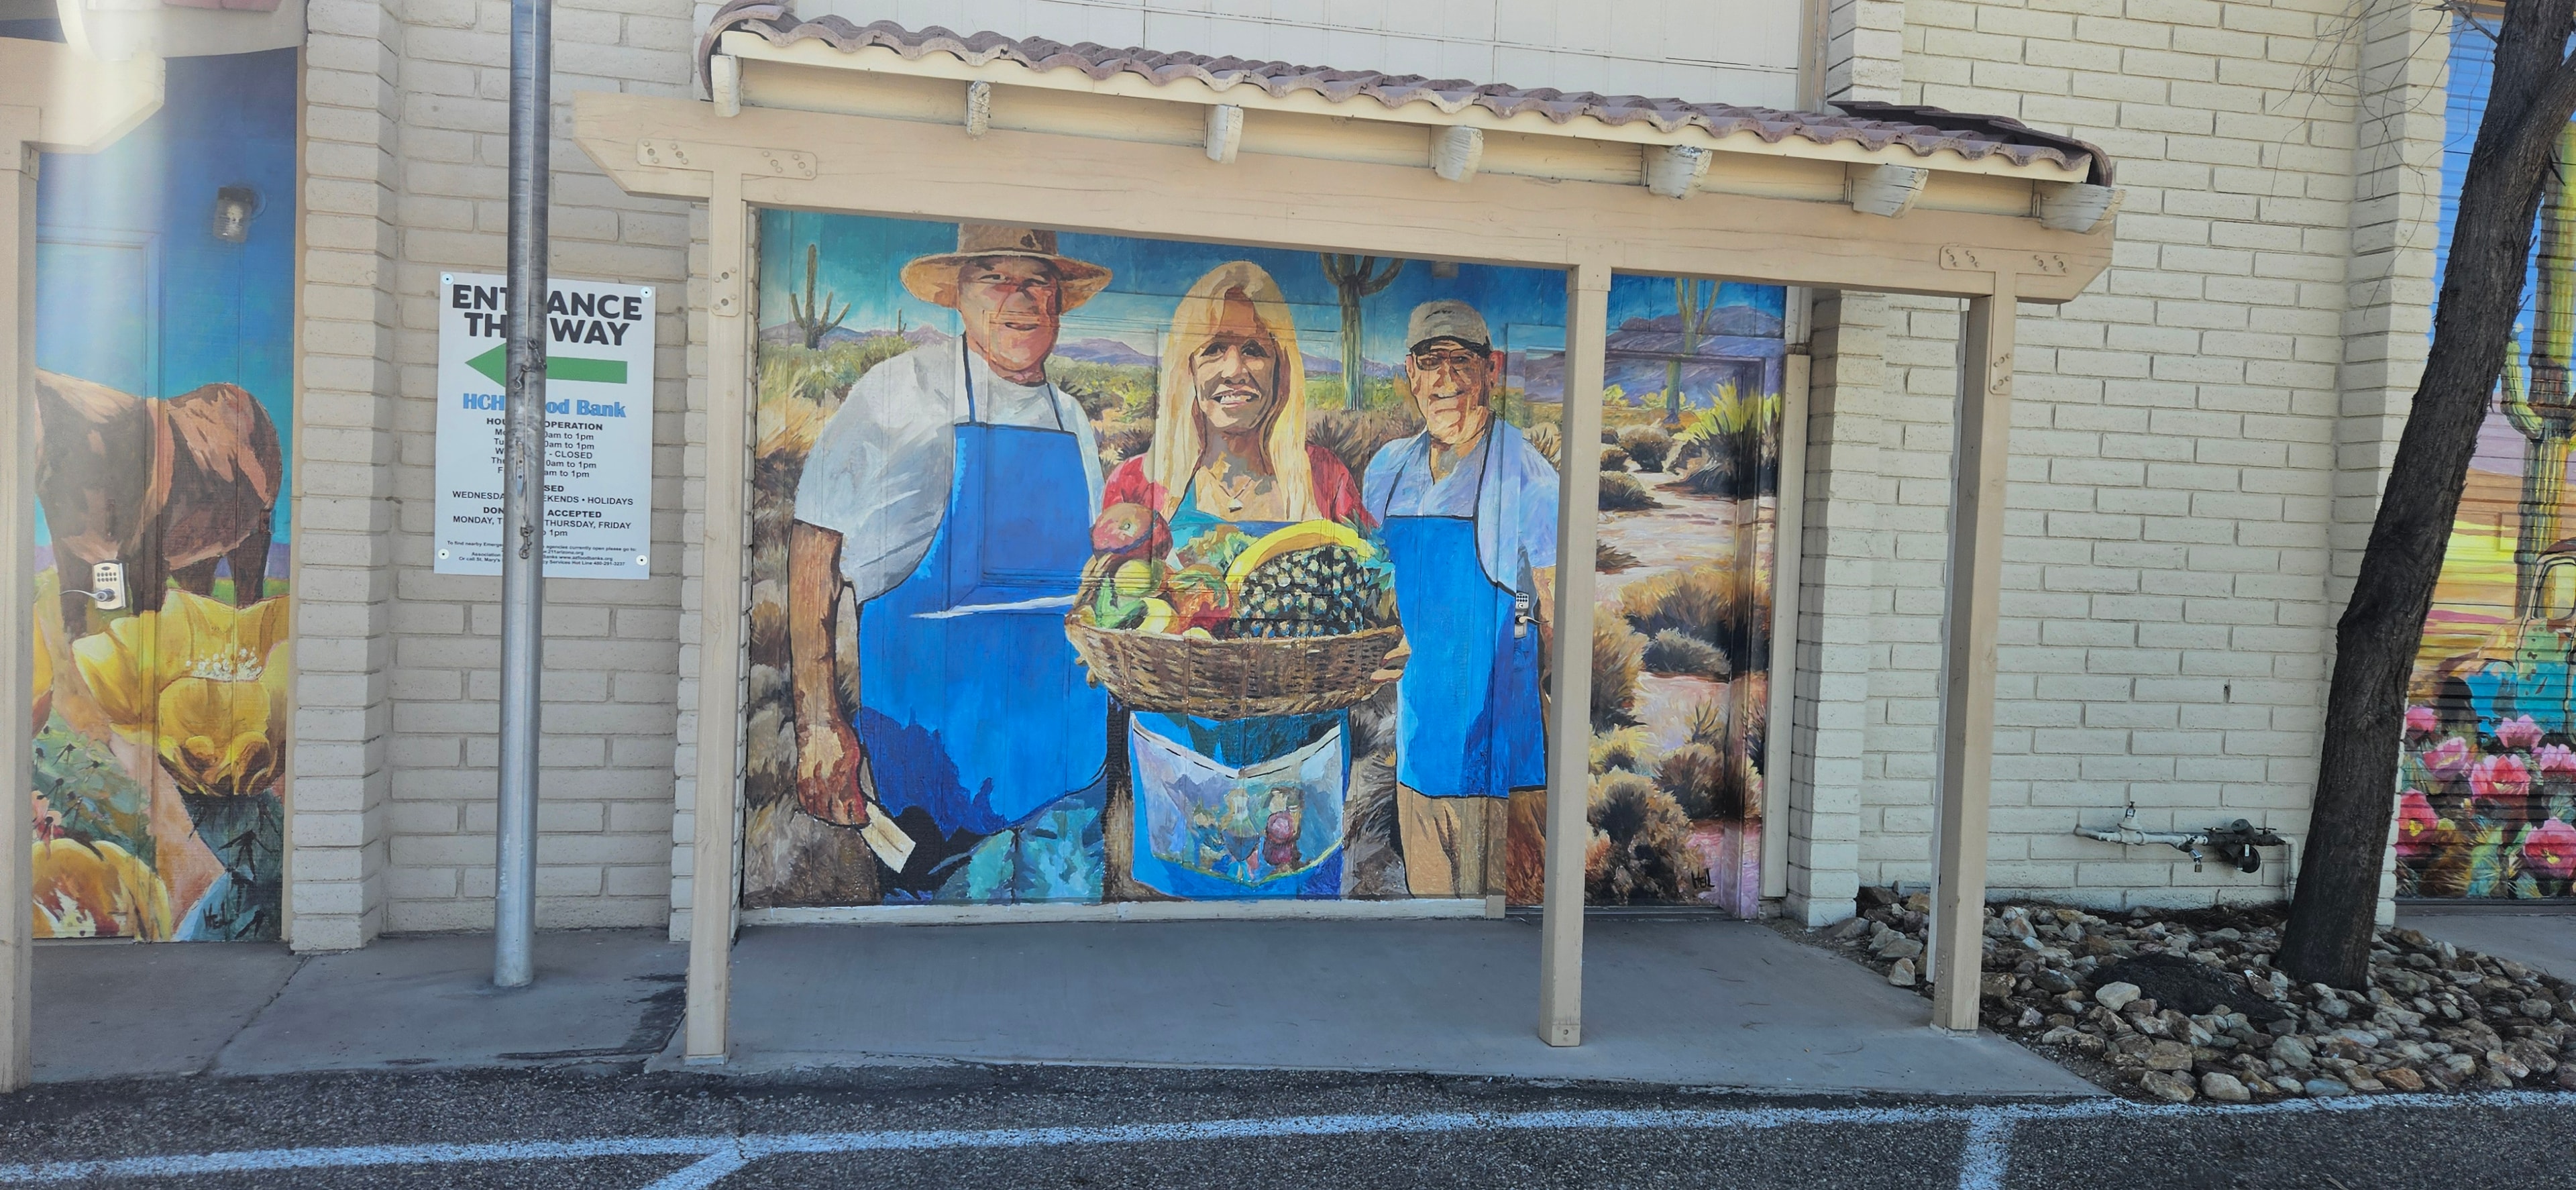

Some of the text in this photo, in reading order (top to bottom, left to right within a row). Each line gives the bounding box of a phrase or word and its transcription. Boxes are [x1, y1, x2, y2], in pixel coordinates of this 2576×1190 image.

[452, 284, 642, 321] ENANCE
[549, 317, 630, 345] WAY
[545, 398, 570, 415] od
[576, 399, 627, 418] Bank
[545, 421, 603, 431] OPERATION
[544, 431, 594, 441] 0am to 1pm
[565, 440, 574, 449] to
[576, 442, 594, 450] 1pm
[555, 450, 593, 459] CLOSED
[567, 459, 576, 468] to
[578, 462, 597, 470] 1pm
[544, 484, 564, 492] SED
[452, 490, 634, 505] WEDNESDA EKENDS HOLIDAYS
[547, 509, 602, 518] ACCEPTED
[453, 515, 494, 525] MONDAY,
[545, 519, 596, 529] THURSDAY,
[598, 521, 632, 529] FRIDAY
